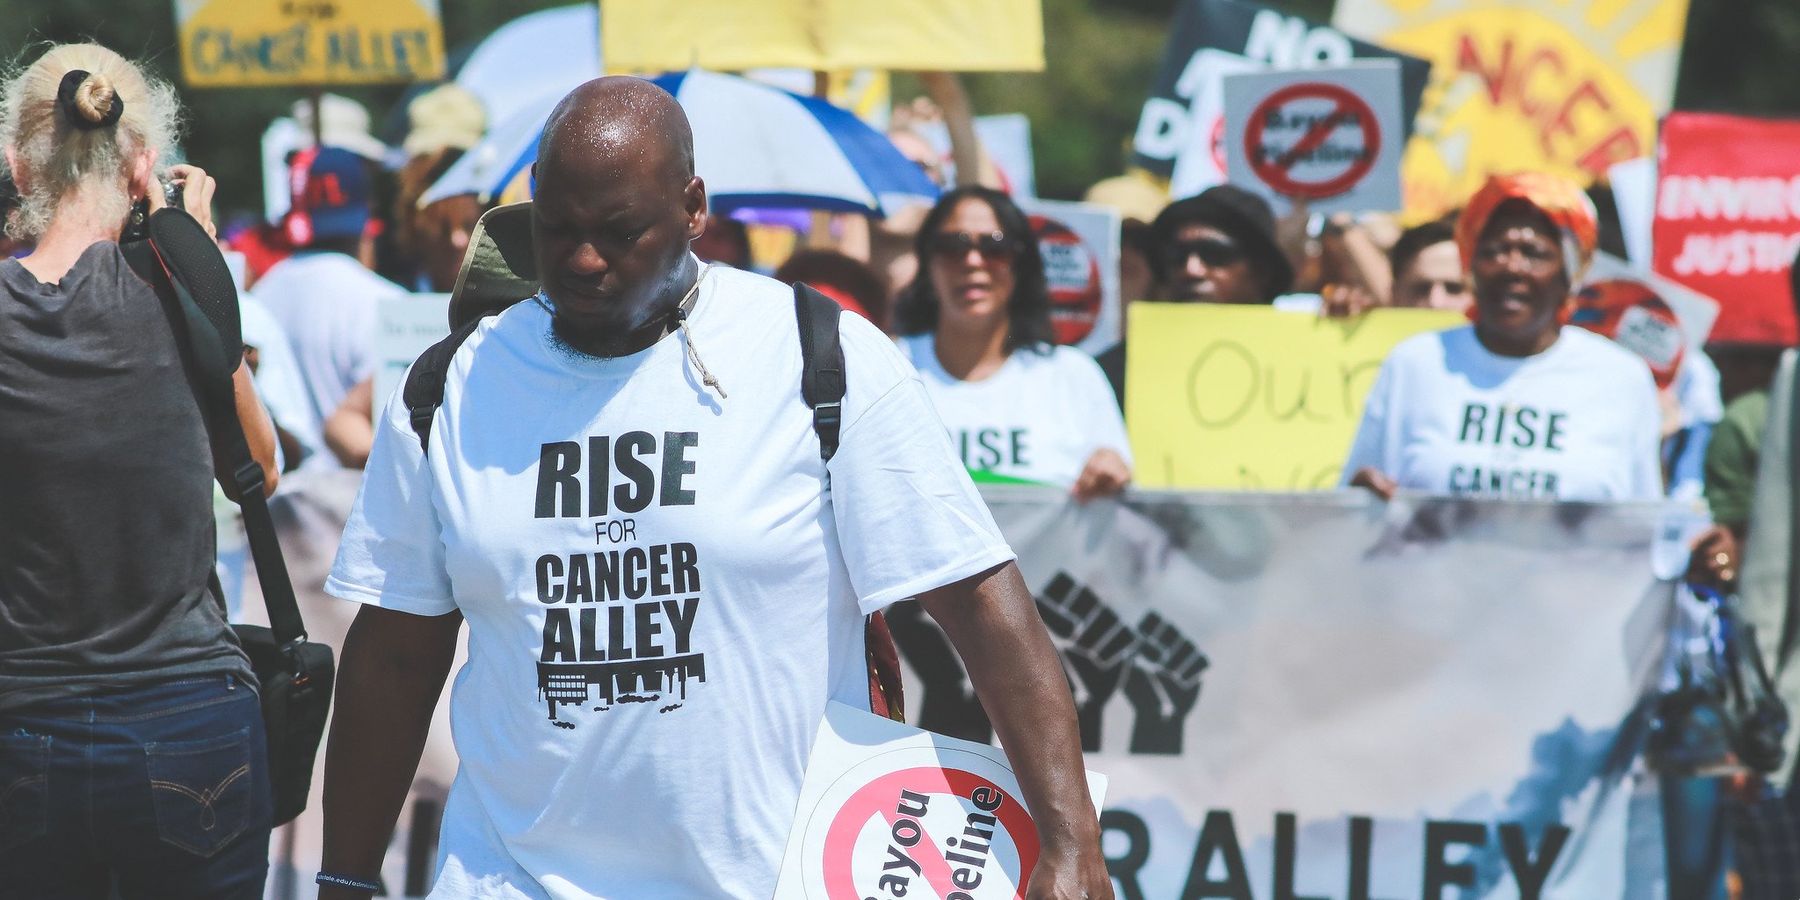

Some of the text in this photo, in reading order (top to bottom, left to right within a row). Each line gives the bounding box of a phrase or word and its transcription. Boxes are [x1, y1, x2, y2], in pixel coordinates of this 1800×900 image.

[1245, 8, 1353, 68] NO
[1659, 174, 1800, 220] ENVIR
[1187, 338, 1384, 431] Our
[957, 428, 1032, 470] ISE
[1459, 403, 1567, 452] RISE
[534, 430, 699, 518] RISE
[1449, 463, 1560, 498] CANCER
[595, 519, 637, 545] FOR
[535, 542, 701, 604] CANCER
[540, 598, 701, 663] ALLEY
[863, 788, 931, 900] ayou
